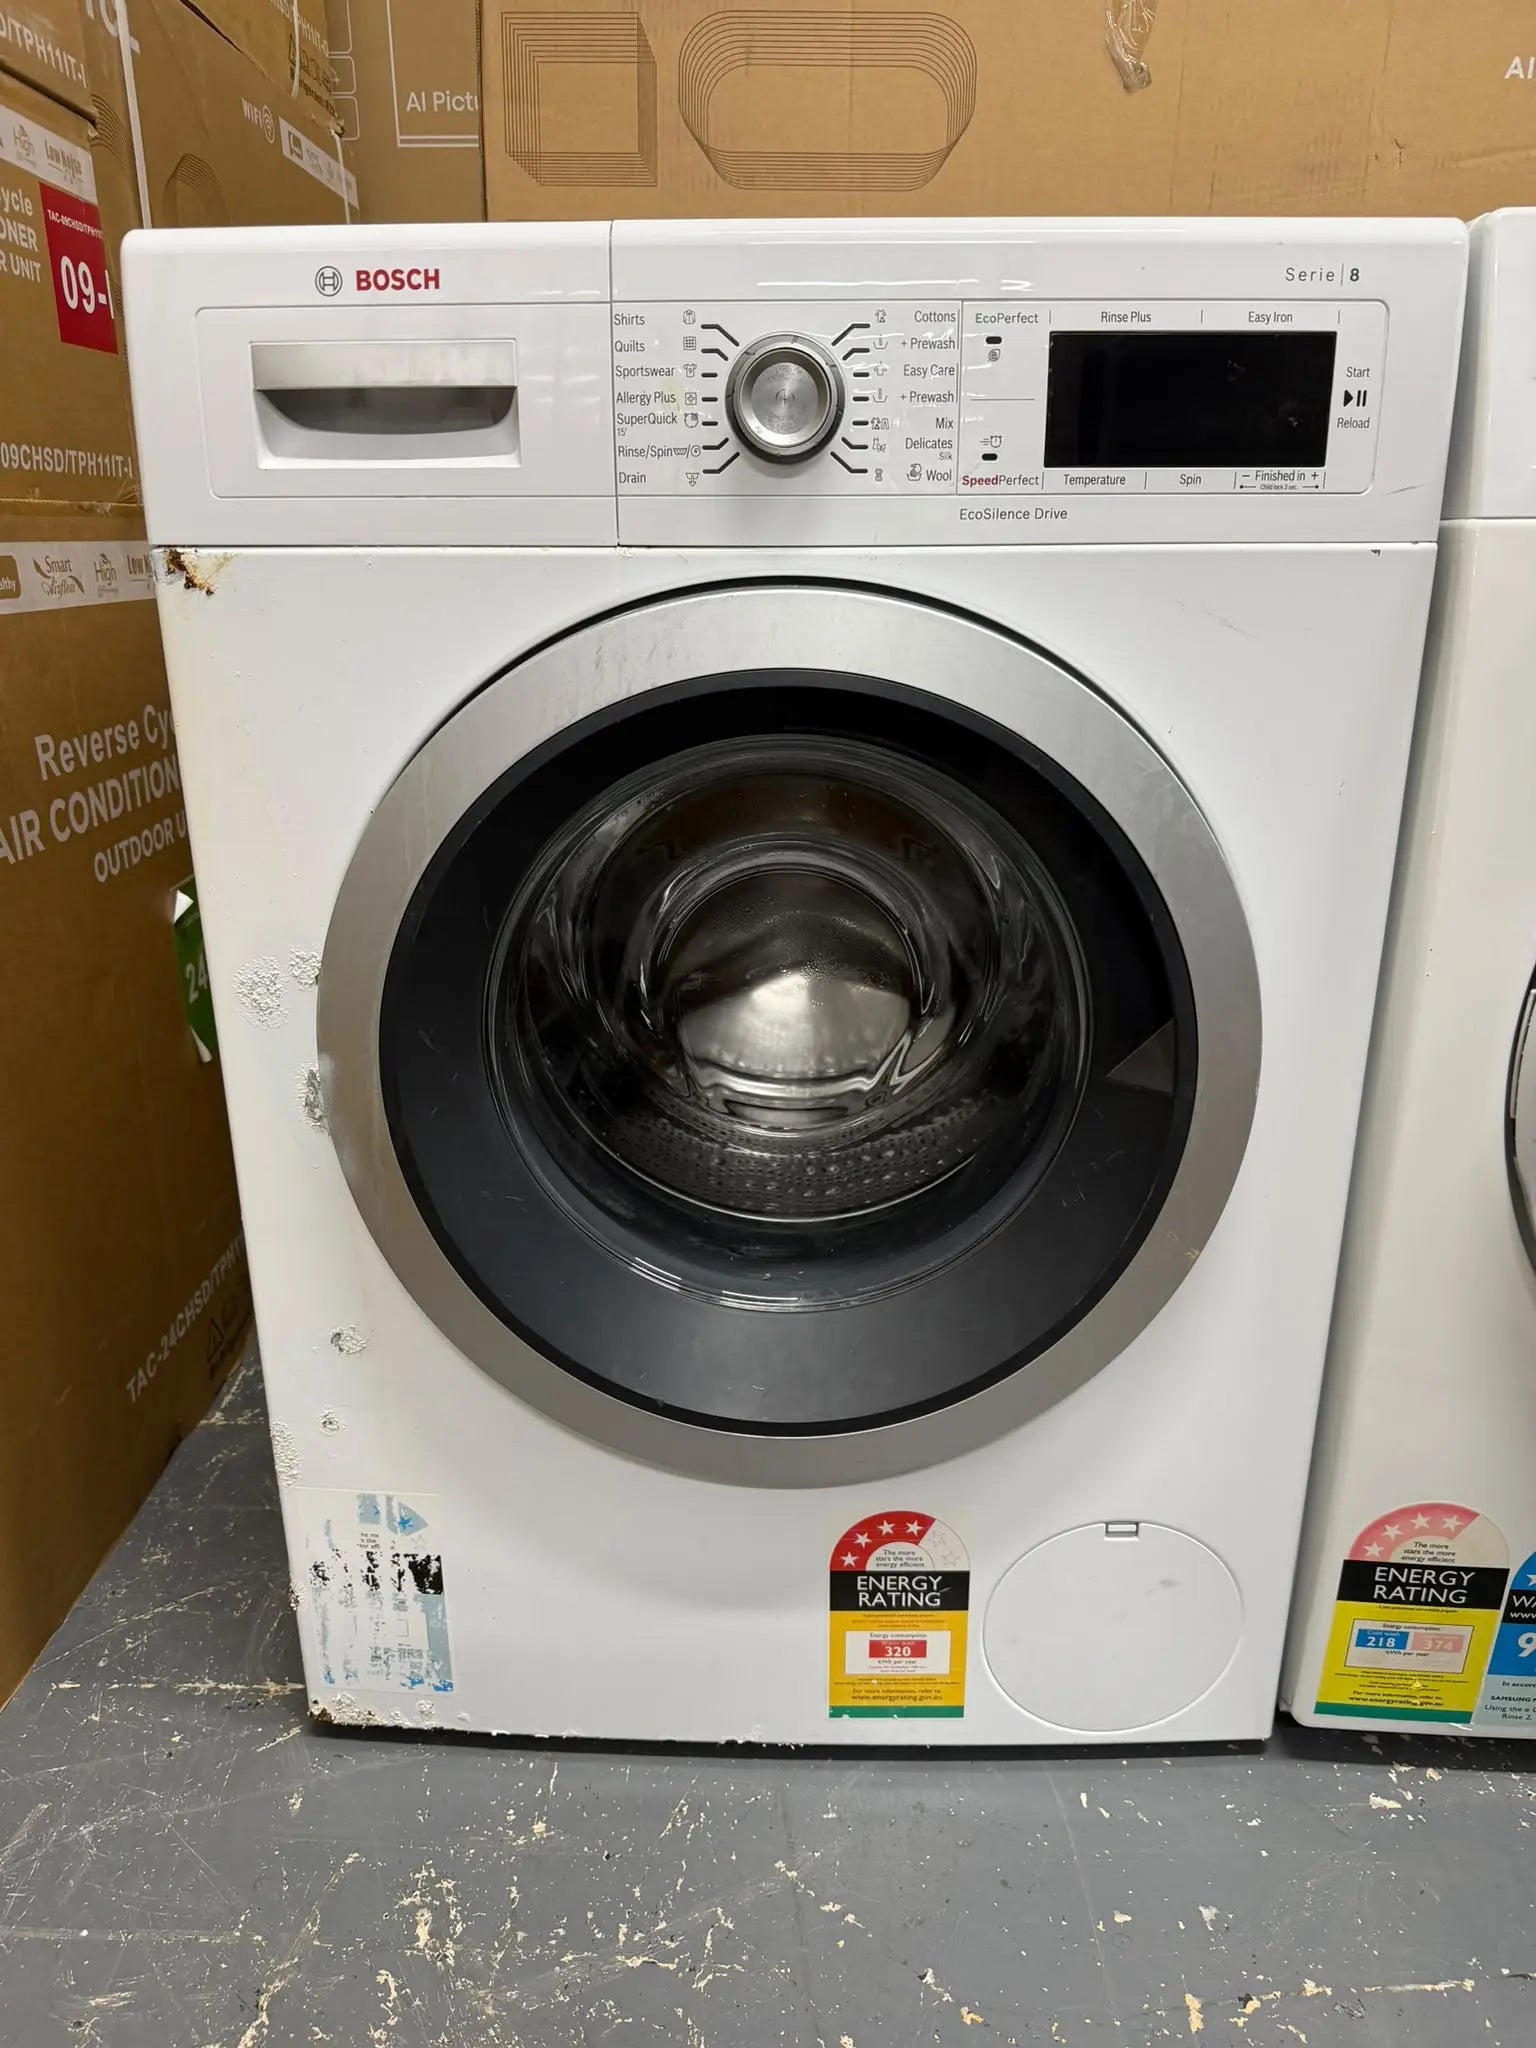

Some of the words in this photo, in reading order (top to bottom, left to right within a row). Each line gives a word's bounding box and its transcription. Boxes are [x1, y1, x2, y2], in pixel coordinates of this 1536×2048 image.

[407, 91, 426, 112] AI
[9, 252, 41, 283] UNIT
[356, 268, 440, 291] BOSCH
[1285, 267, 1335, 282] Serie
[1350, 268, 1360, 282] 8
[614, 313, 645, 326] Shirts
[914, 310, 956, 323] Cottons
[975, 312, 1039, 324] EcoPerfect
[1100, 311, 1128, 323] Rinse
[1130, 311, 1151, 323] Plus
[1248, 311, 1272, 325] Easy
[1274, 311, 1293, 323] Iron
[614, 340, 646, 352] Quilts
[910, 338, 956, 350] Prewash
[615, 365, 675, 379] Sportswear
[903, 364, 927, 379] Easy
[930, 364, 955, 377] Care
[1346, 366, 1370, 378] Start
[616, 391, 652, 406] Allergy
[654, 391, 676, 403] Plus
[909, 390, 954, 403] Prewash
[617, 412, 678, 427] SuperQuick
[935, 417, 954, 430] Mix
[1337, 417, 1370, 429] Reload
[905, 437, 953, 450] Delicates
[618, 445, 673, 459] Rinse/Spin
[938, 451, 953, 460] Silk
[618, 471, 646, 484] Drain
[926, 469, 952, 482] Wool
[962, 475, 1039, 488] SpeedPerfect
[1063, 474, 1126, 487] Temperature
[1179, 474, 1202, 487] Spin
[1255, 470, 1296, 481] Finished
[1296, 470, 1306, 481] in
[960, 508, 1030, 521] EcoSilence
[1035, 508, 1068, 520] Drive
[45, 555, 73, 573] Smart
[35, 720, 139, 781] Reverse
[50, 754, 180, 842] CONDITION
[94, 817, 175, 883] OUTDOOR
[186, 952, 208, 1004] 24
[1374, 1566, 1476, 1587] ENERGY
[857, 1576, 942, 1591] ENERGY
[858, 1592, 941, 1607] RATING
[1373, 1584, 1468, 1604] RATING
[1512, 1595, 1536, 1608] W
[1366, 1636, 1396, 1648] 218
[885, 1646, 911, 1657] 320
[1485, 1704, 1507, 1712] Using
